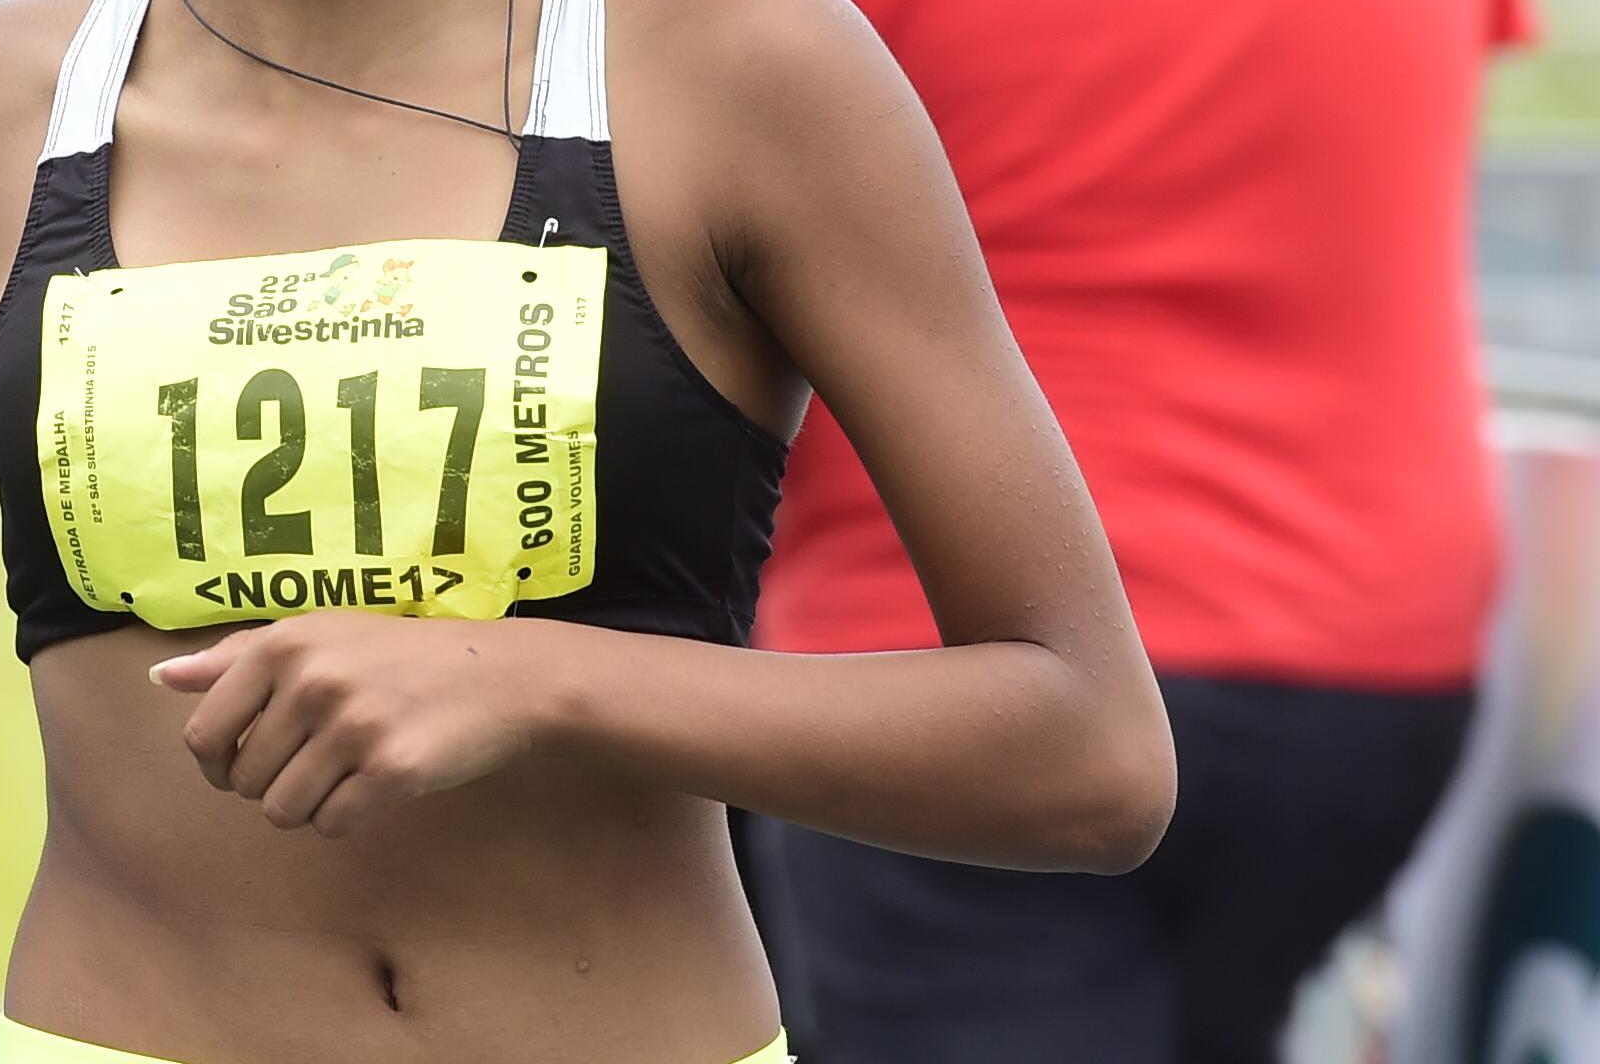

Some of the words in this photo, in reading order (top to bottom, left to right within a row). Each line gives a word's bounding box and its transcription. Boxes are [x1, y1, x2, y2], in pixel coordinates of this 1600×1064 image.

[260, 272, 316, 294] 22ª
[58, 302, 75, 346] 1217
[227, 293, 298, 319] São
[575, 297, 587, 326] 1217
[208, 312, 425, 346] Silvestrinha
[85, 345, 97, 375] 2015
[512, 302, 554, 464] METROS
[84, 379, 97, 470] SILVESTRINHA
[53, 410, 71, 495] MEDALHA
[157, 366, 487, 563] 1217
[567, 430, 583, 510] VOLUMES
[86, 473, 100, 500] SÃO
[60, 499, 76, 523] DE
[516, 479, 554, 550] 600
[67, 527, 99, 602] RETIRADA
[568, 511, 583, 577] GUARDA
[194, 564, 464, 608] <NOME1>
